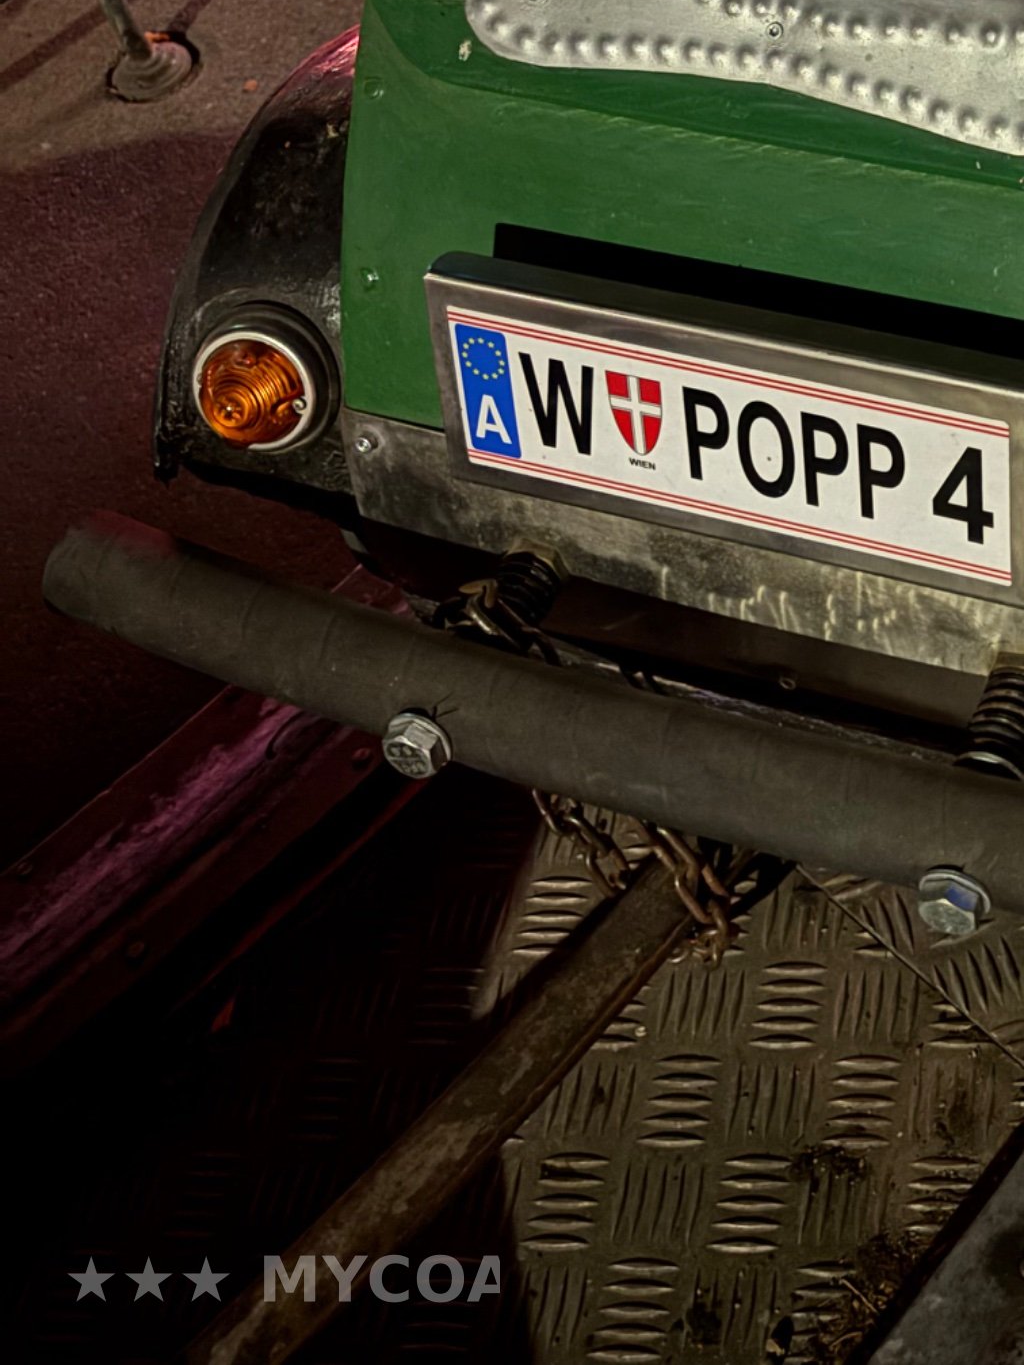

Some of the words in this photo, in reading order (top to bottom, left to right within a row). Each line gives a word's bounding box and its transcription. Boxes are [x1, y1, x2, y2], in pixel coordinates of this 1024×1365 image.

[475, 394, 512, 445] A
[518, 351, 594, 456] W
[682, 386, 906, 520] POPP
[932, 446, 994, 545] 4
[628, 456, 656, 471] WIEN
